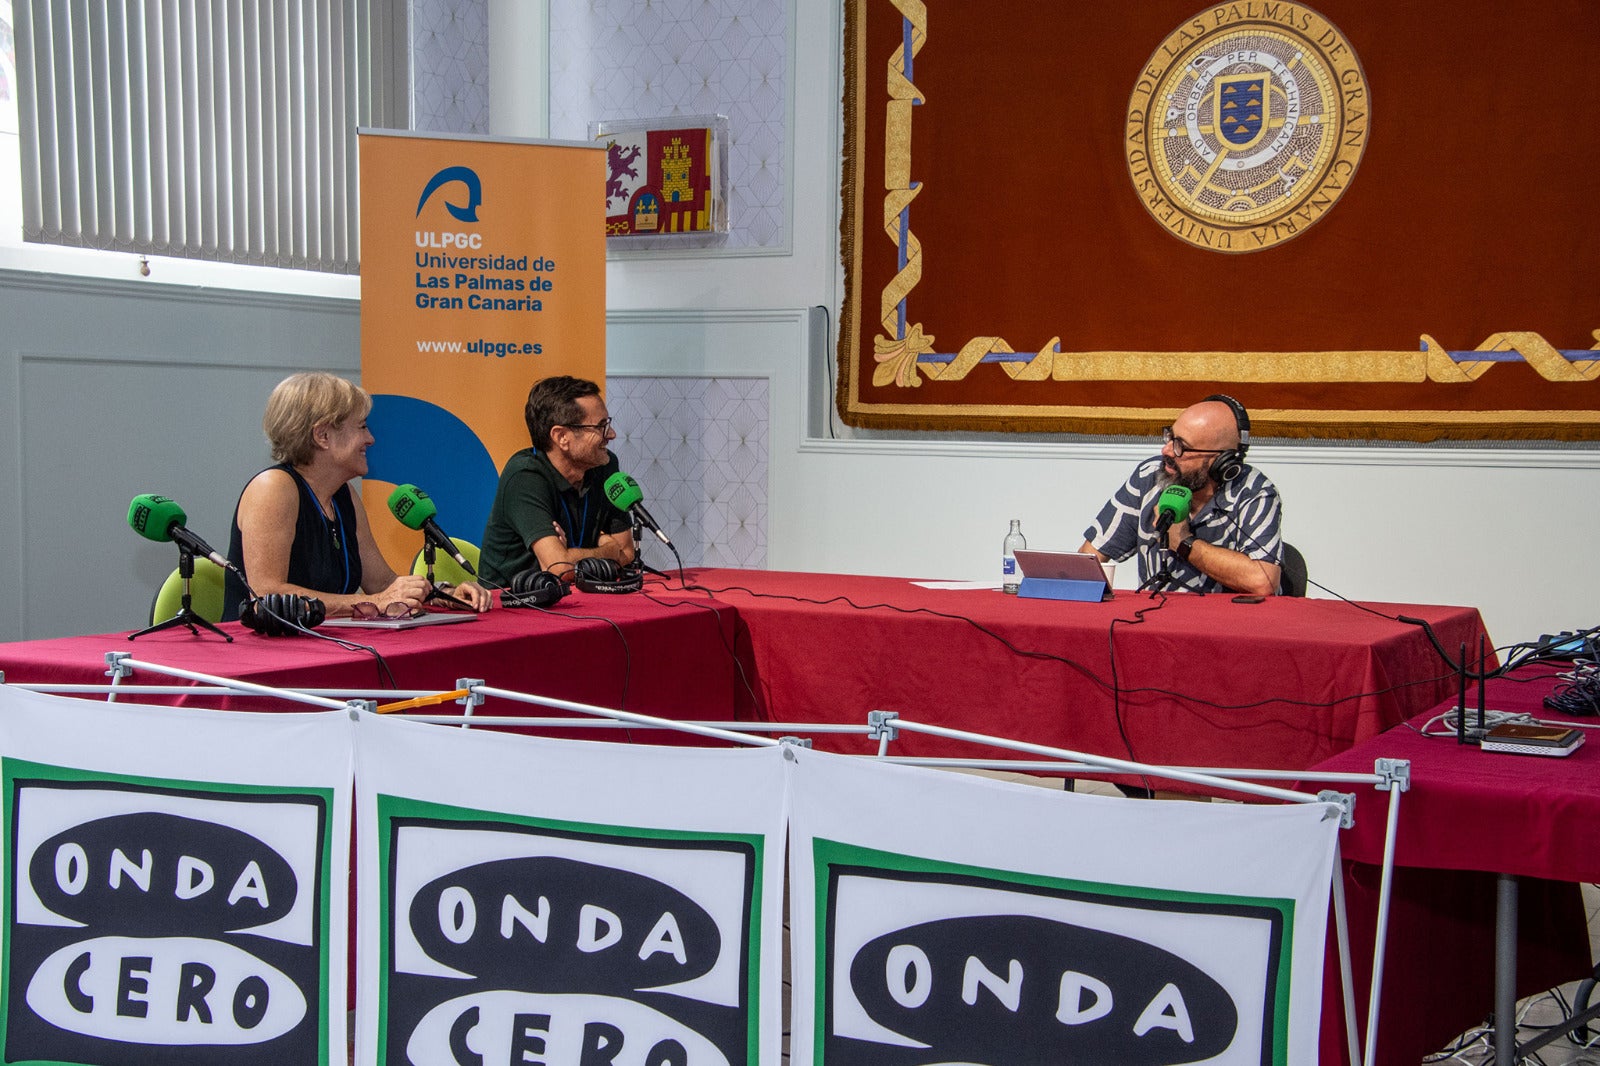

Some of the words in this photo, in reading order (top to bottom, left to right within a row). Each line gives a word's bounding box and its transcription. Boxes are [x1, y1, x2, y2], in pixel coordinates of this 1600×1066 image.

[1213, 2, 1313, 32] PALMAS
[1163, 20, 1206, 57] LAS
[1317, 28, 1348, 62] DE
[1136, 63, 1164, 97] DE
[1187, 70, 1214, 122] ORBEM
[1227, 51, 1258, 63] PER
[1271, 61, 1299, 154] TECHNICAM
[1341, 69, 1366, 148] GRAN
[1128, 108, 1232, 249] UNIVERSIDAD
[1251, 159, 1354, 246] CANARIA
[415, 231, 482, 249] ULPGC
[415, 252, 528, 271] Universidad
[532, 256, 556, 273] de
[415, 272, 450, 289] Las
[454, 273, 525, 292] Palmas
[529, 276, 553, 292] de
[415, 293, 463, 310] Gran
[467, 294, 543, 312] Canaria
[416, 339, 543, 357] www.ulpgc.es
[54, 842, 271, 909] ONDA
[437, 886, 688, 965] ONDA
[63, 951, 271, 1031] CERO
[885, 943, 1195, 1043] ONDA
